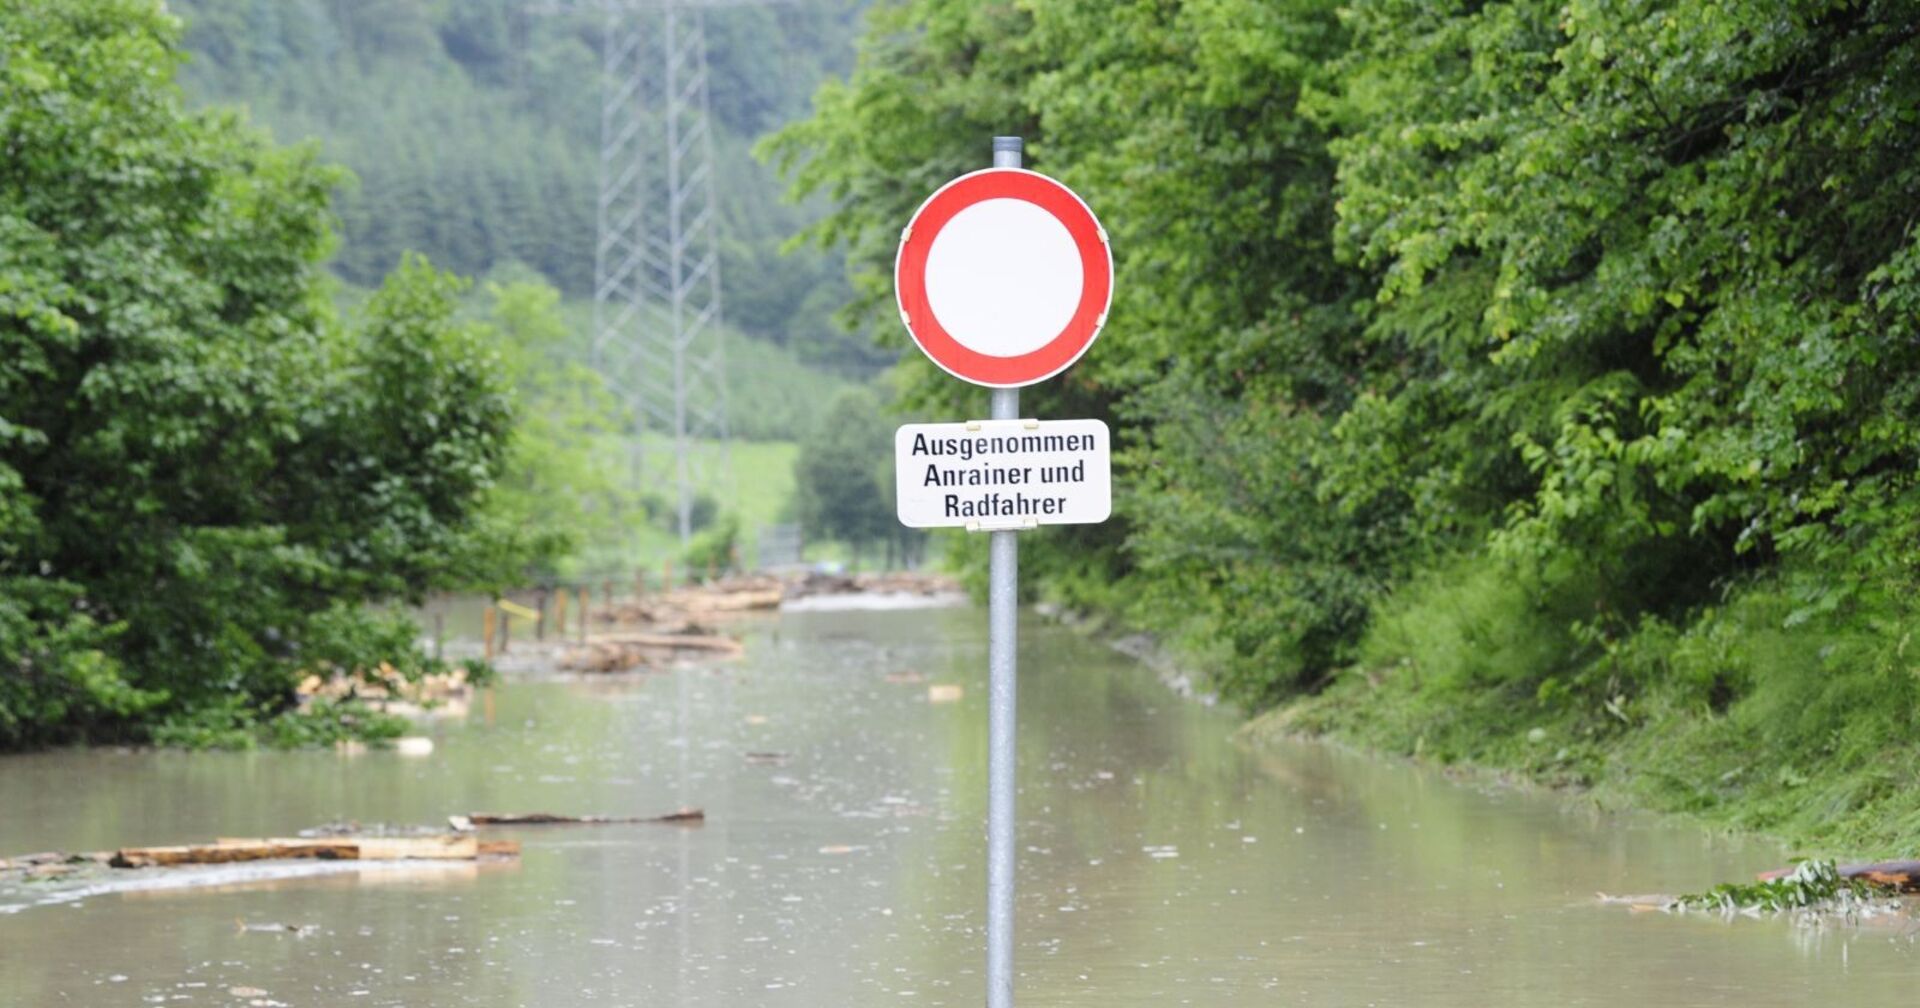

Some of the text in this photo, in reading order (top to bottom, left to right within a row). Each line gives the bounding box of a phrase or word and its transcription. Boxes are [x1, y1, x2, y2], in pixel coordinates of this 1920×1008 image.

[912, 433, 1096, 461] Ausgenommen
[924, 459, 1085, 487] Anrainer und
[945, 492, 1067, 518] Radfahrer
